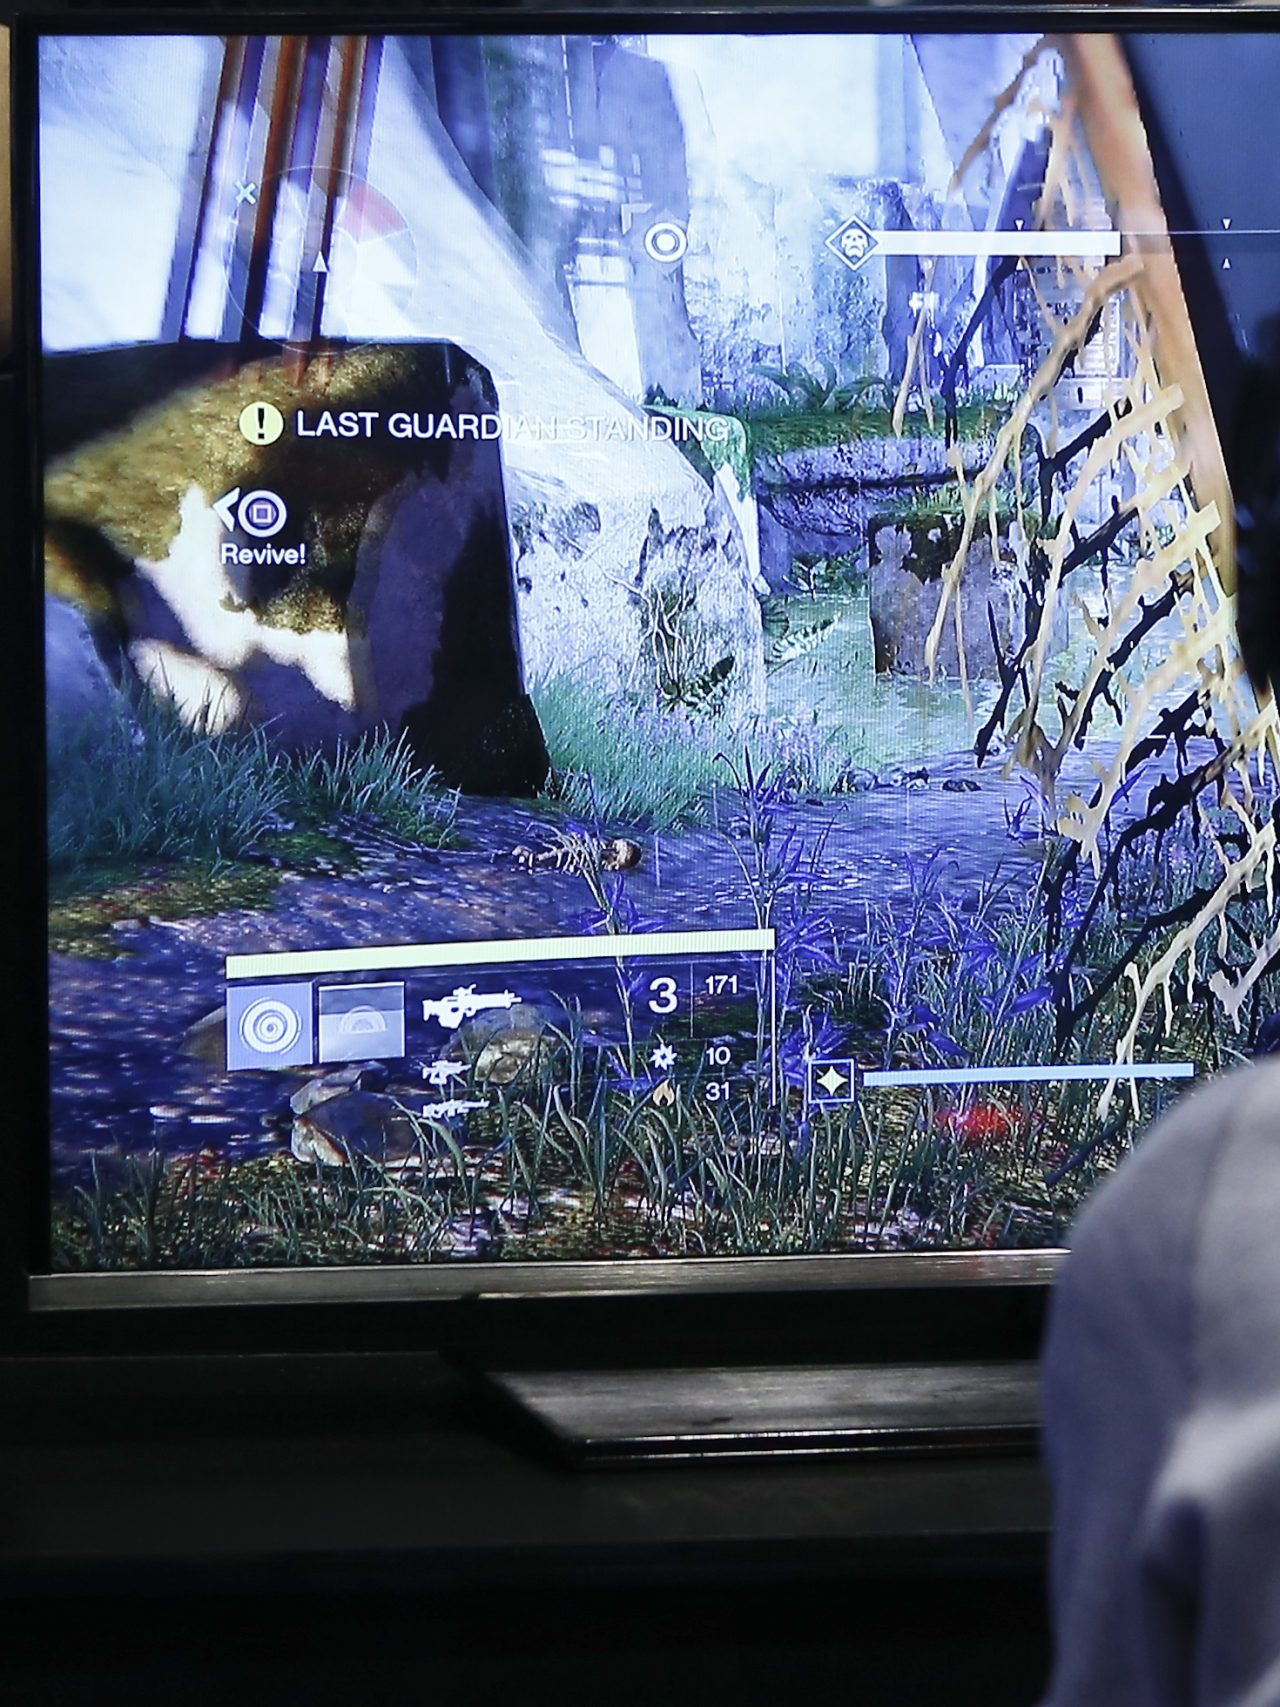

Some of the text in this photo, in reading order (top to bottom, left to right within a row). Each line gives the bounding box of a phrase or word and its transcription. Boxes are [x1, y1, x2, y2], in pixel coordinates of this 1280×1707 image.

[297, 410, 729, 441] LAST GUARDIAN STANDING
[221, 542, 306, 565] Revive!
[648, 977, 678, 1014] 3
[705, 974, 738, 995] 171
[706, 1046, 731, 1066] 10
[705, 1081, 730, 1101] 31
